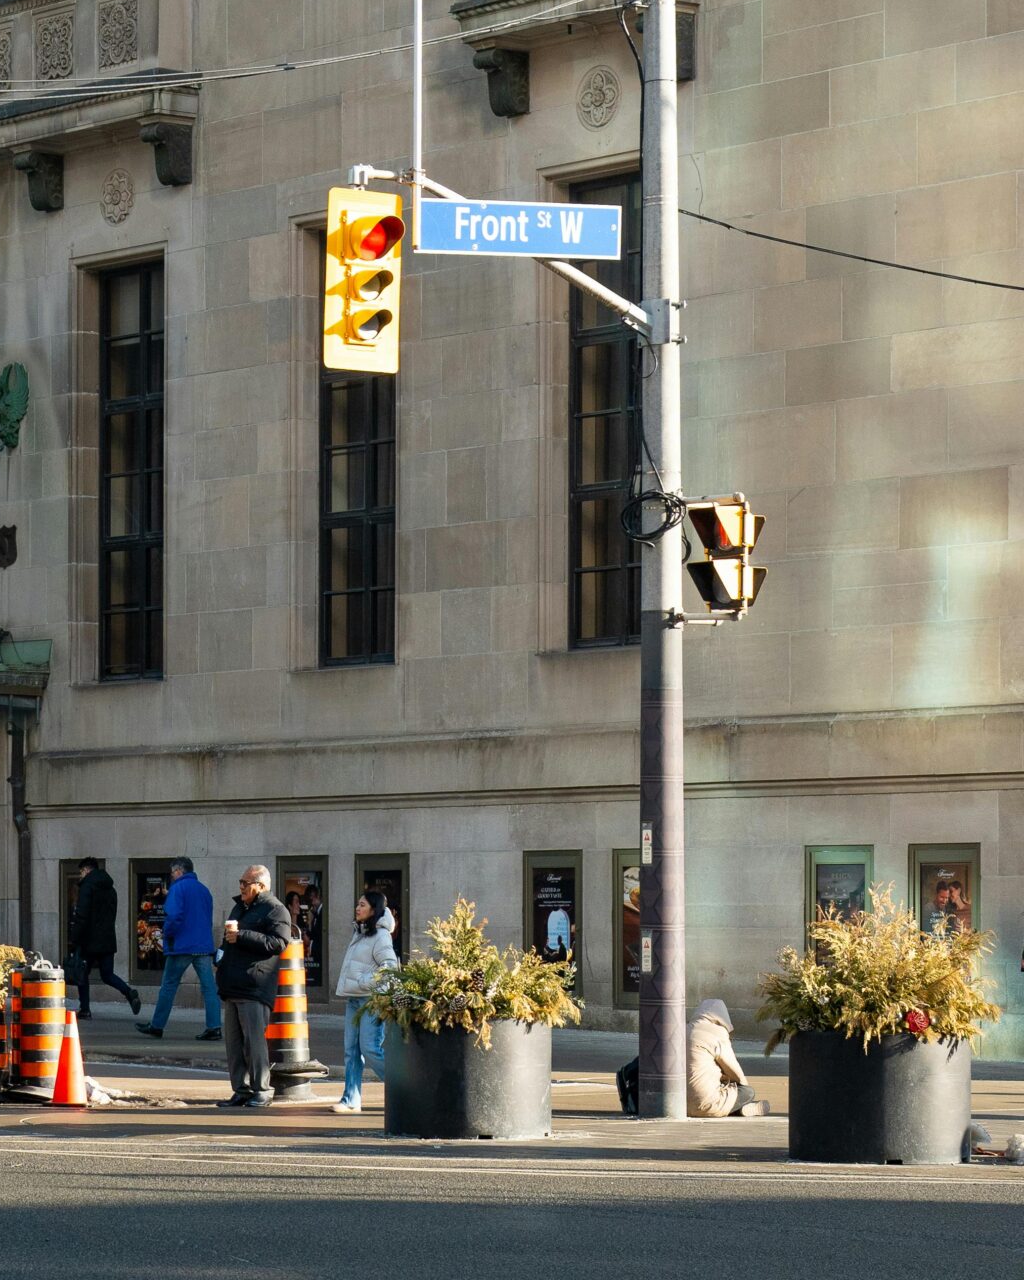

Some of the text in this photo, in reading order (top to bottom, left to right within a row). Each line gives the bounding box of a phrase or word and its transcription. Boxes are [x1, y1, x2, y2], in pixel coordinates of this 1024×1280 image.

[455, 206, 584, 244] Front St W
